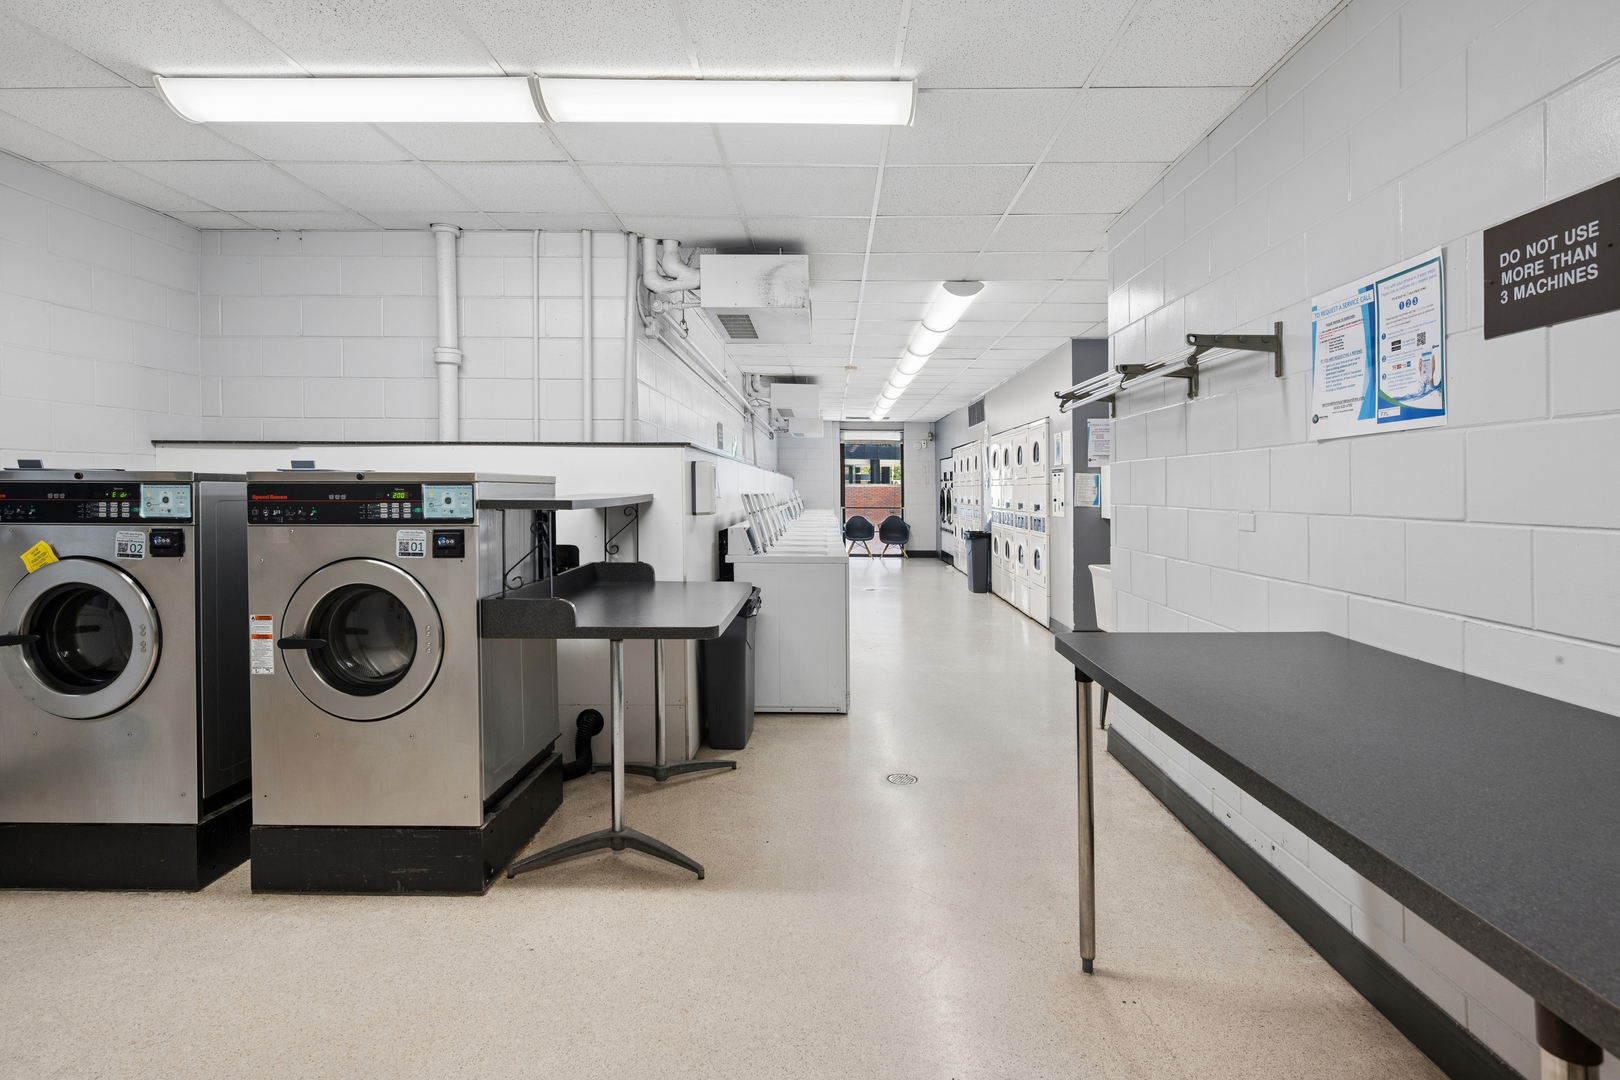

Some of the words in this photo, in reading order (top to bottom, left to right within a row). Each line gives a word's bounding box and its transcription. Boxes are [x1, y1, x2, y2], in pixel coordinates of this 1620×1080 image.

[1500, 249, 1520, 268] DO
[1526, 234, 1558, 258] NOT
[1564, 220, 1600, 246] USE
[1501, 259, 1544, 286] MORE
[1550, 242, 1598, 270] THAN
[1500, 290, 1508, 304] 3
[1514, 263, 1598, 300] MACHINES
[1321, 305, 1338, 317] REQUEST
[1342, 298, 1359, 309] SERVICE
[1360, 294, 1372, 302] CALL
[129, 544, 143, 553] 02
[411, 542, 424, 552] 01
